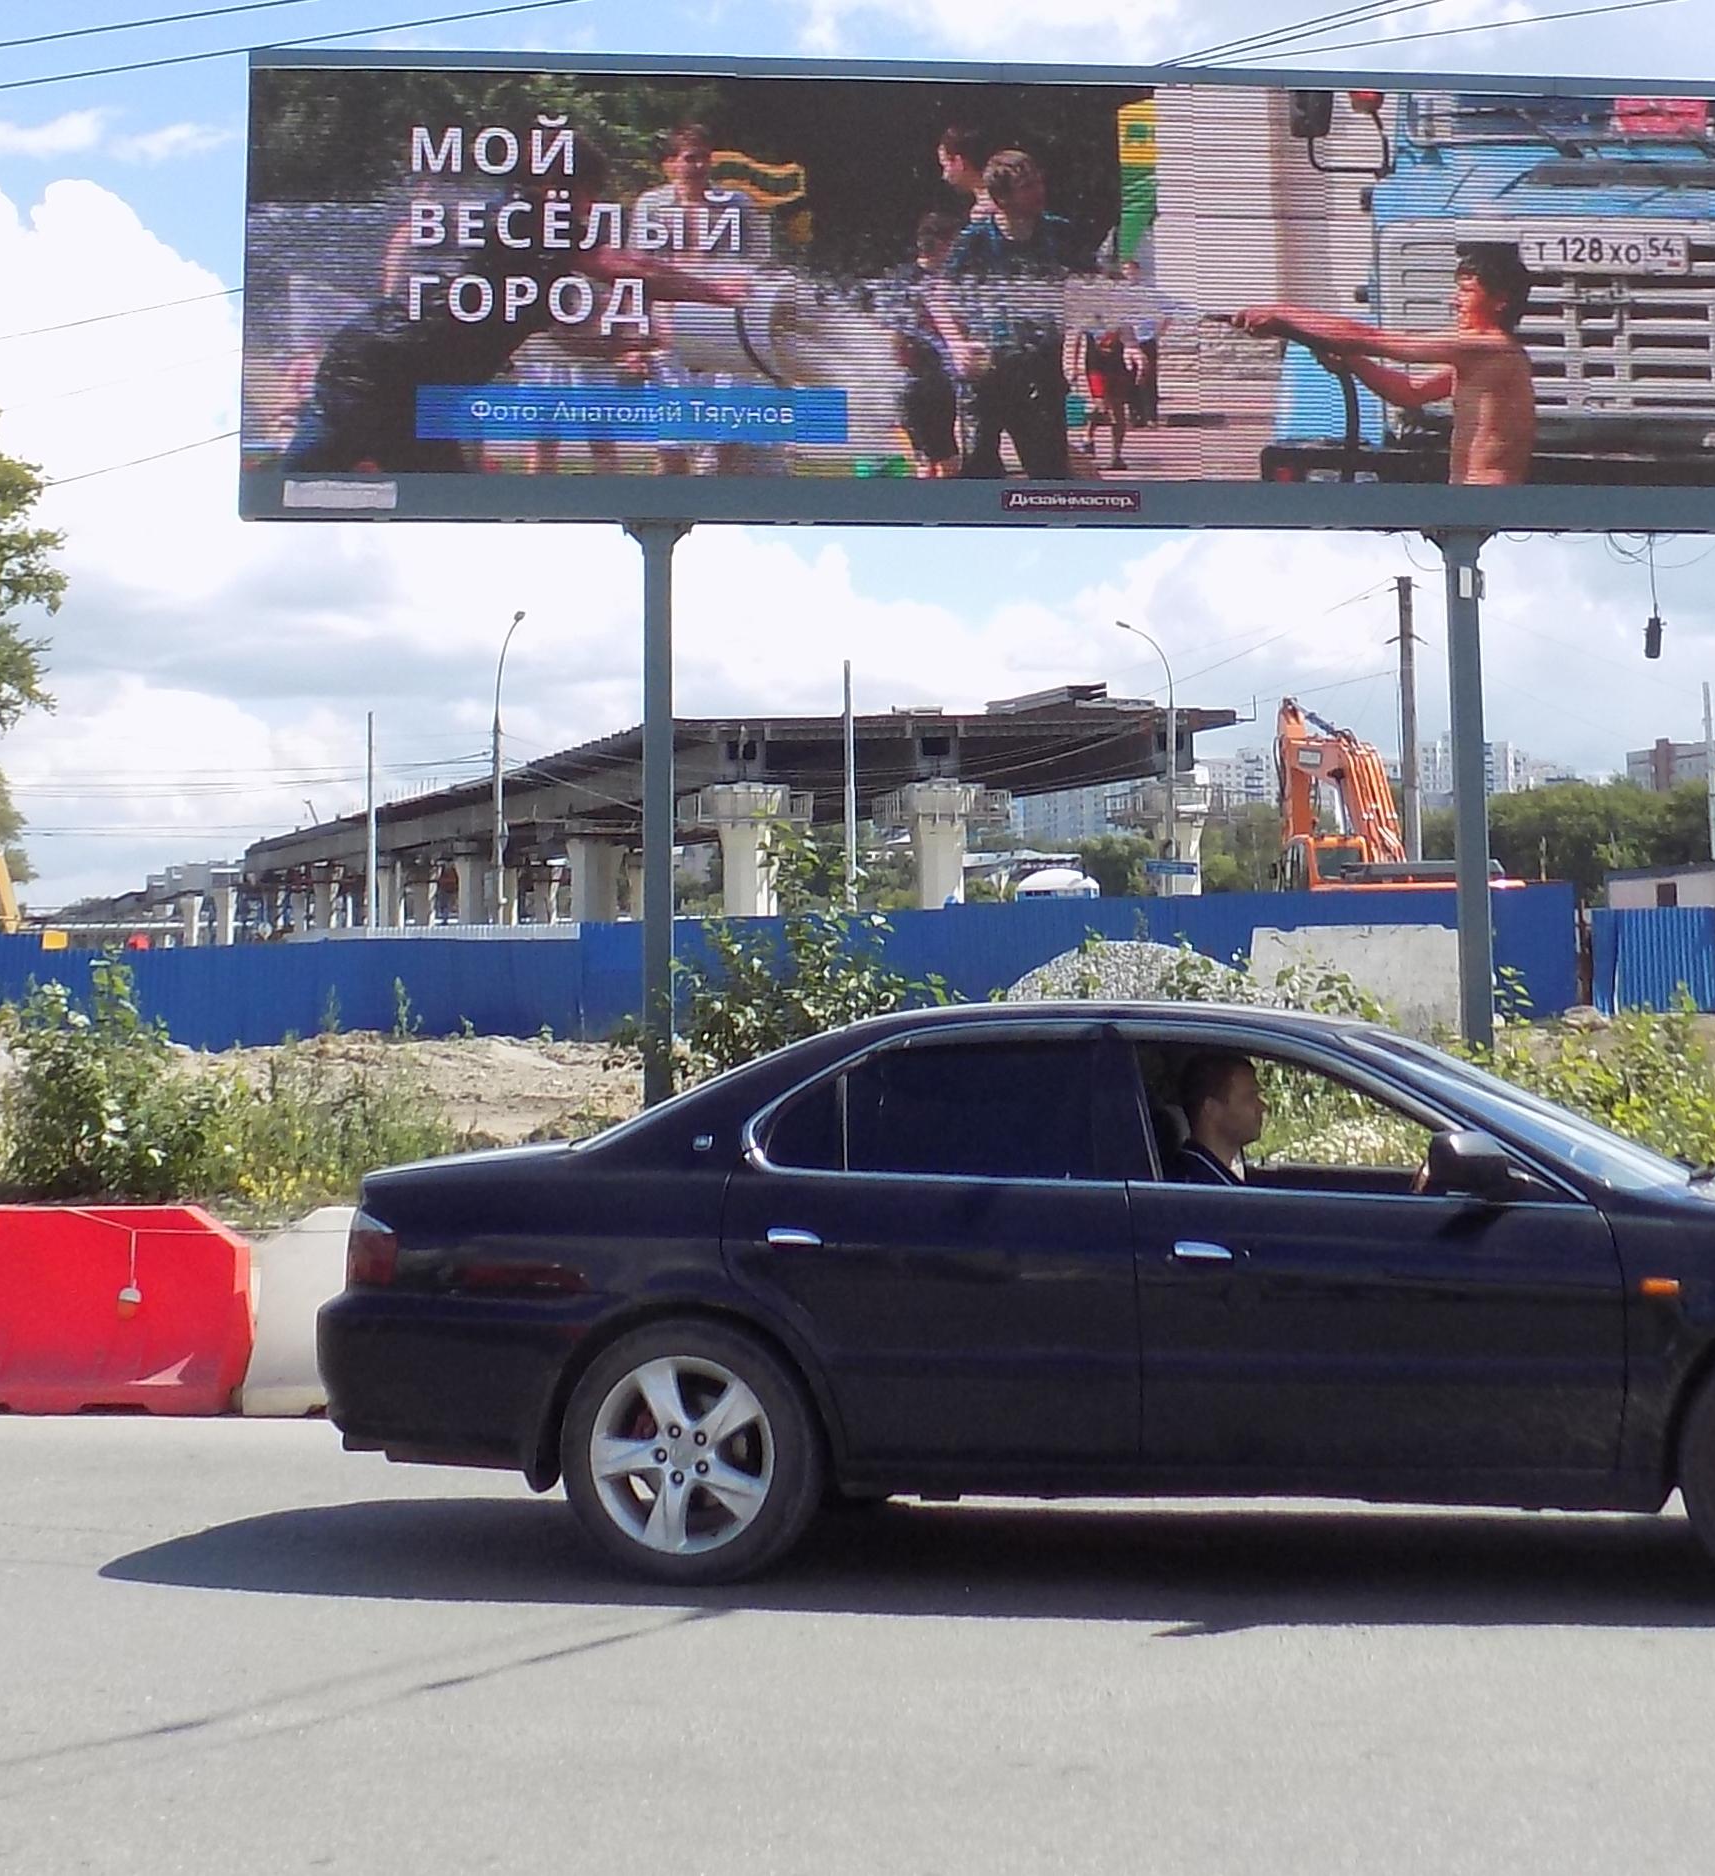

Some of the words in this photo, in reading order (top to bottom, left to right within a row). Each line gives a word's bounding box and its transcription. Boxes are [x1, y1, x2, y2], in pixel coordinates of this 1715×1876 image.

[411, 114, 574, 176] МОЙ
[410, 189, 742, 251] ВЕСЁЛЫЙ
[408, 275, 650, 337] ГОРОД
[471, 400, 546, 421] Фото:
[552, 400, 683, 422] Анатолий
[689, 400, 796, 429] Тягунов
